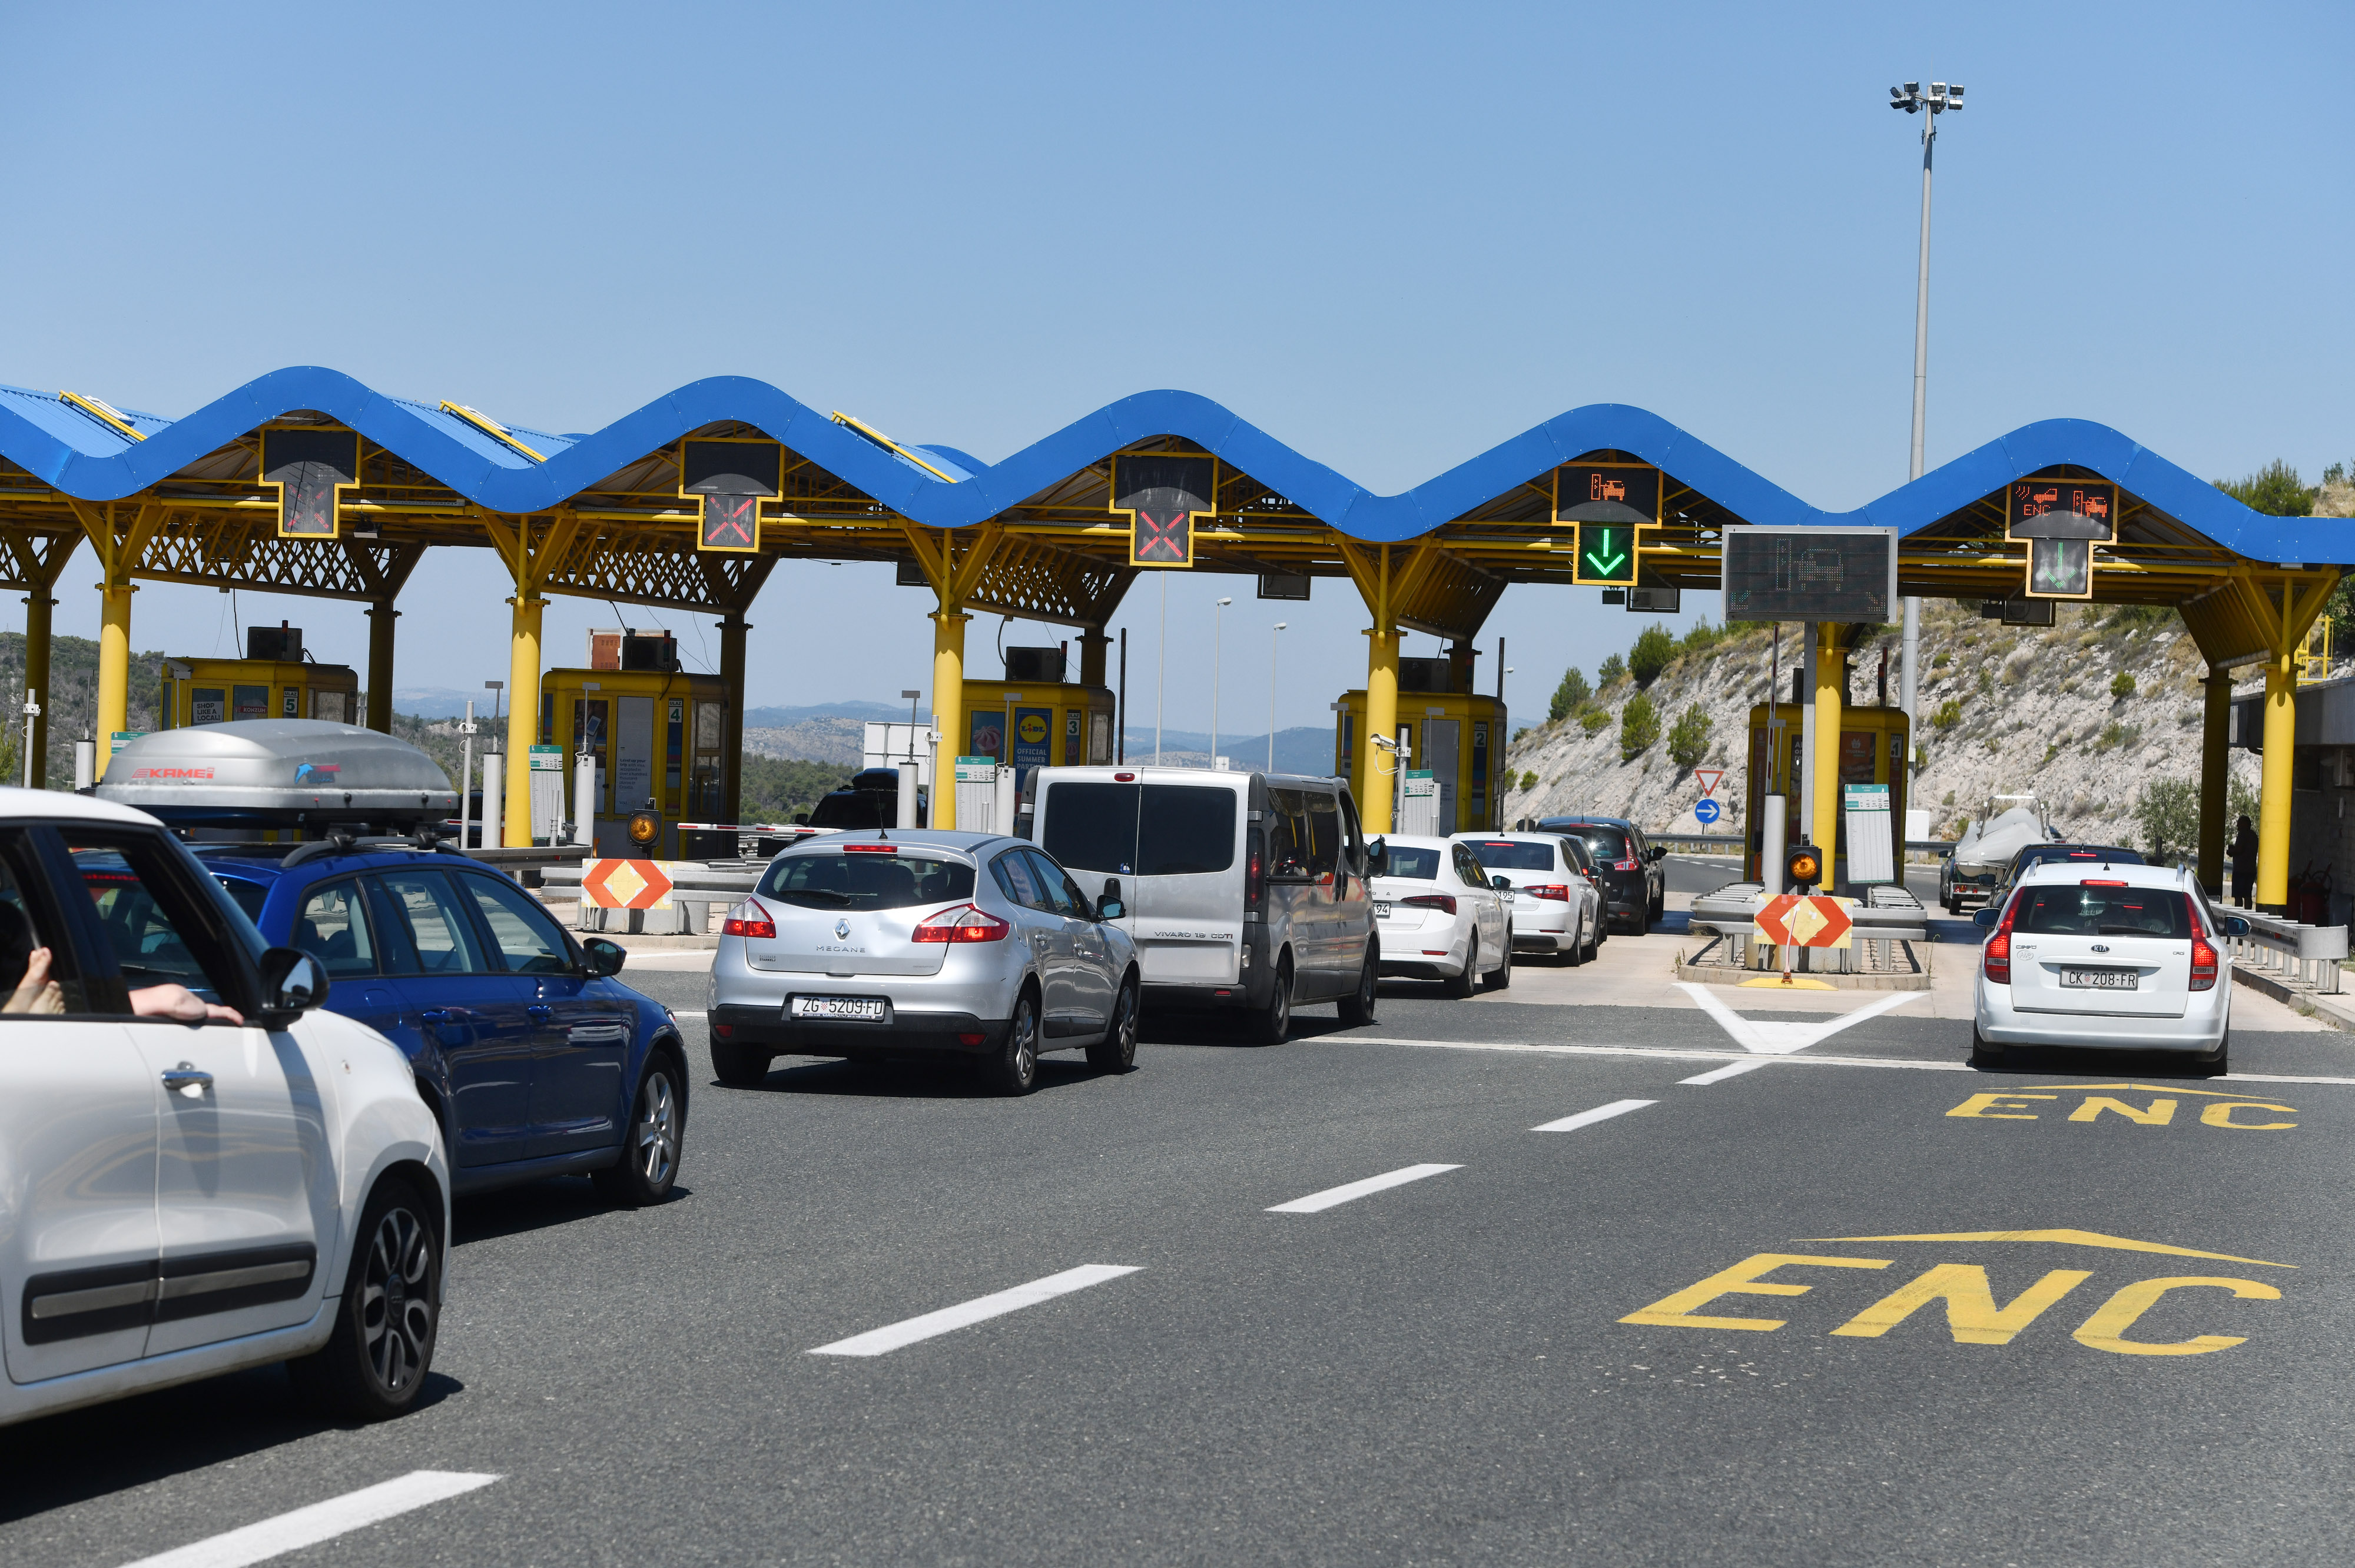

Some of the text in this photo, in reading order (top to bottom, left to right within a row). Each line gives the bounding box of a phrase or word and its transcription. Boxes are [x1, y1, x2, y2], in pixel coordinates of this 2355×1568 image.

[2024, 504, 2051, 516] ENC
[286, 699, 295, 712] 5
[670, 708, 680, 722] 4
[1069, 720, 1077, 734] 3
[1476, 732, 1484, 746] 2
[1893, 742, 1898, 756] 1
[1373, 904, 1388, 913] 94
[2069, 971, 2135, 986] ČK 208-FR
[802, 998, 883, 1015] ZG 5209-FD
[1945, 1092, 2299, 1130] ENC
[1616, 1253, 2283, 1356] ENC
